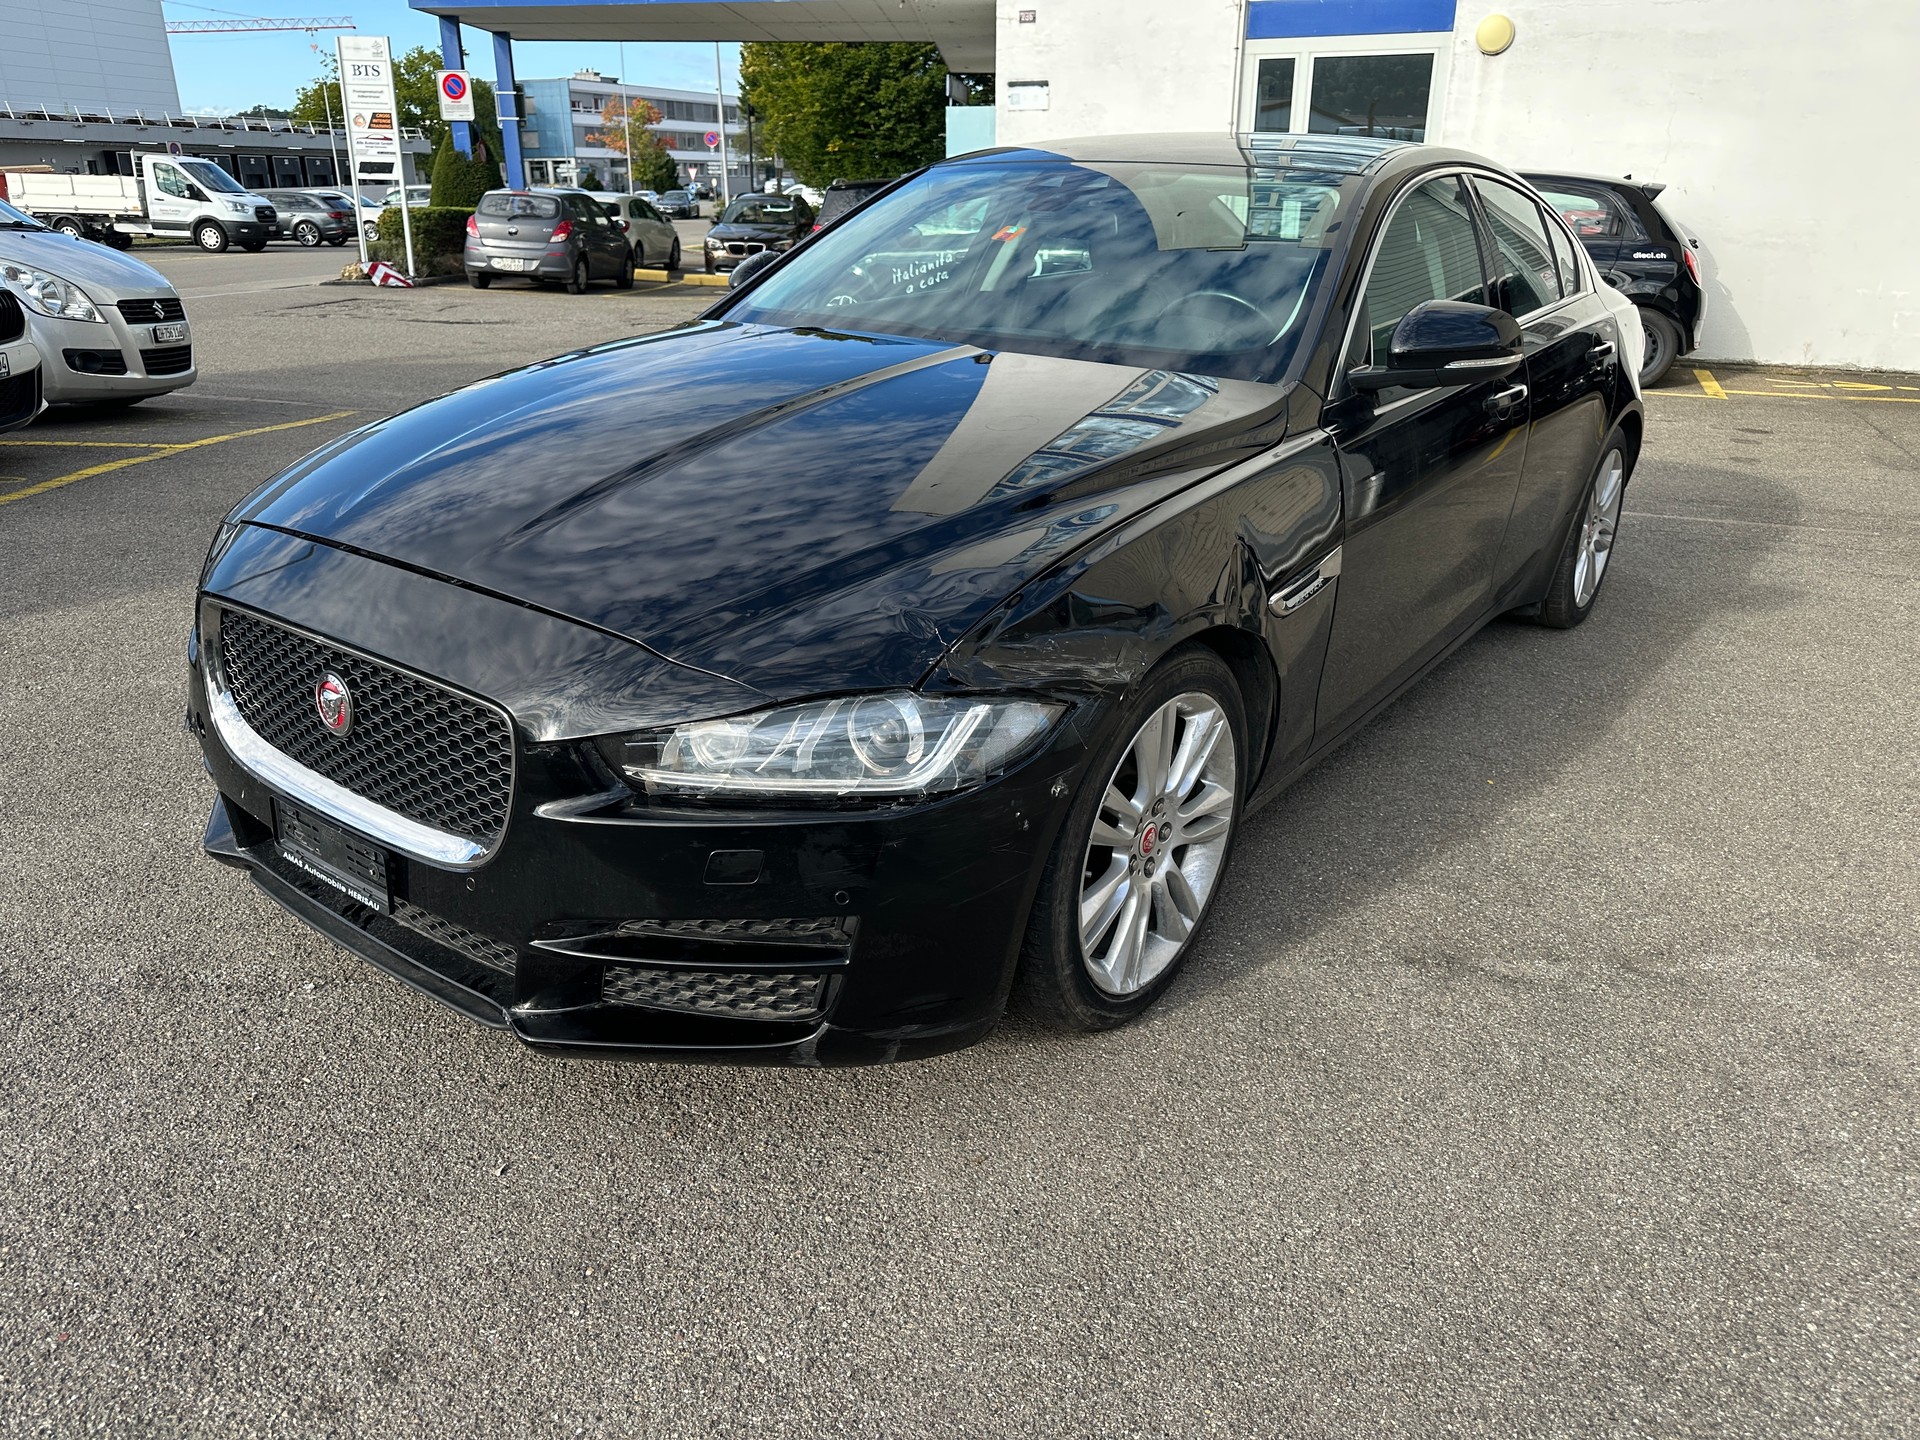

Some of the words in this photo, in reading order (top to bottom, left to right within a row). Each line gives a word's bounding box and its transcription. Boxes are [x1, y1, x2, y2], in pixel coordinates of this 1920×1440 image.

[351, 64, 381, 77] BTS
[906, 284, 913, 293] a
[920, 271, 949, 288] casa
[283, 852, 303, 867] AMAS
[304, 864, 346, 892] Automobile
[348, 888, 380, 911] HERISAU
